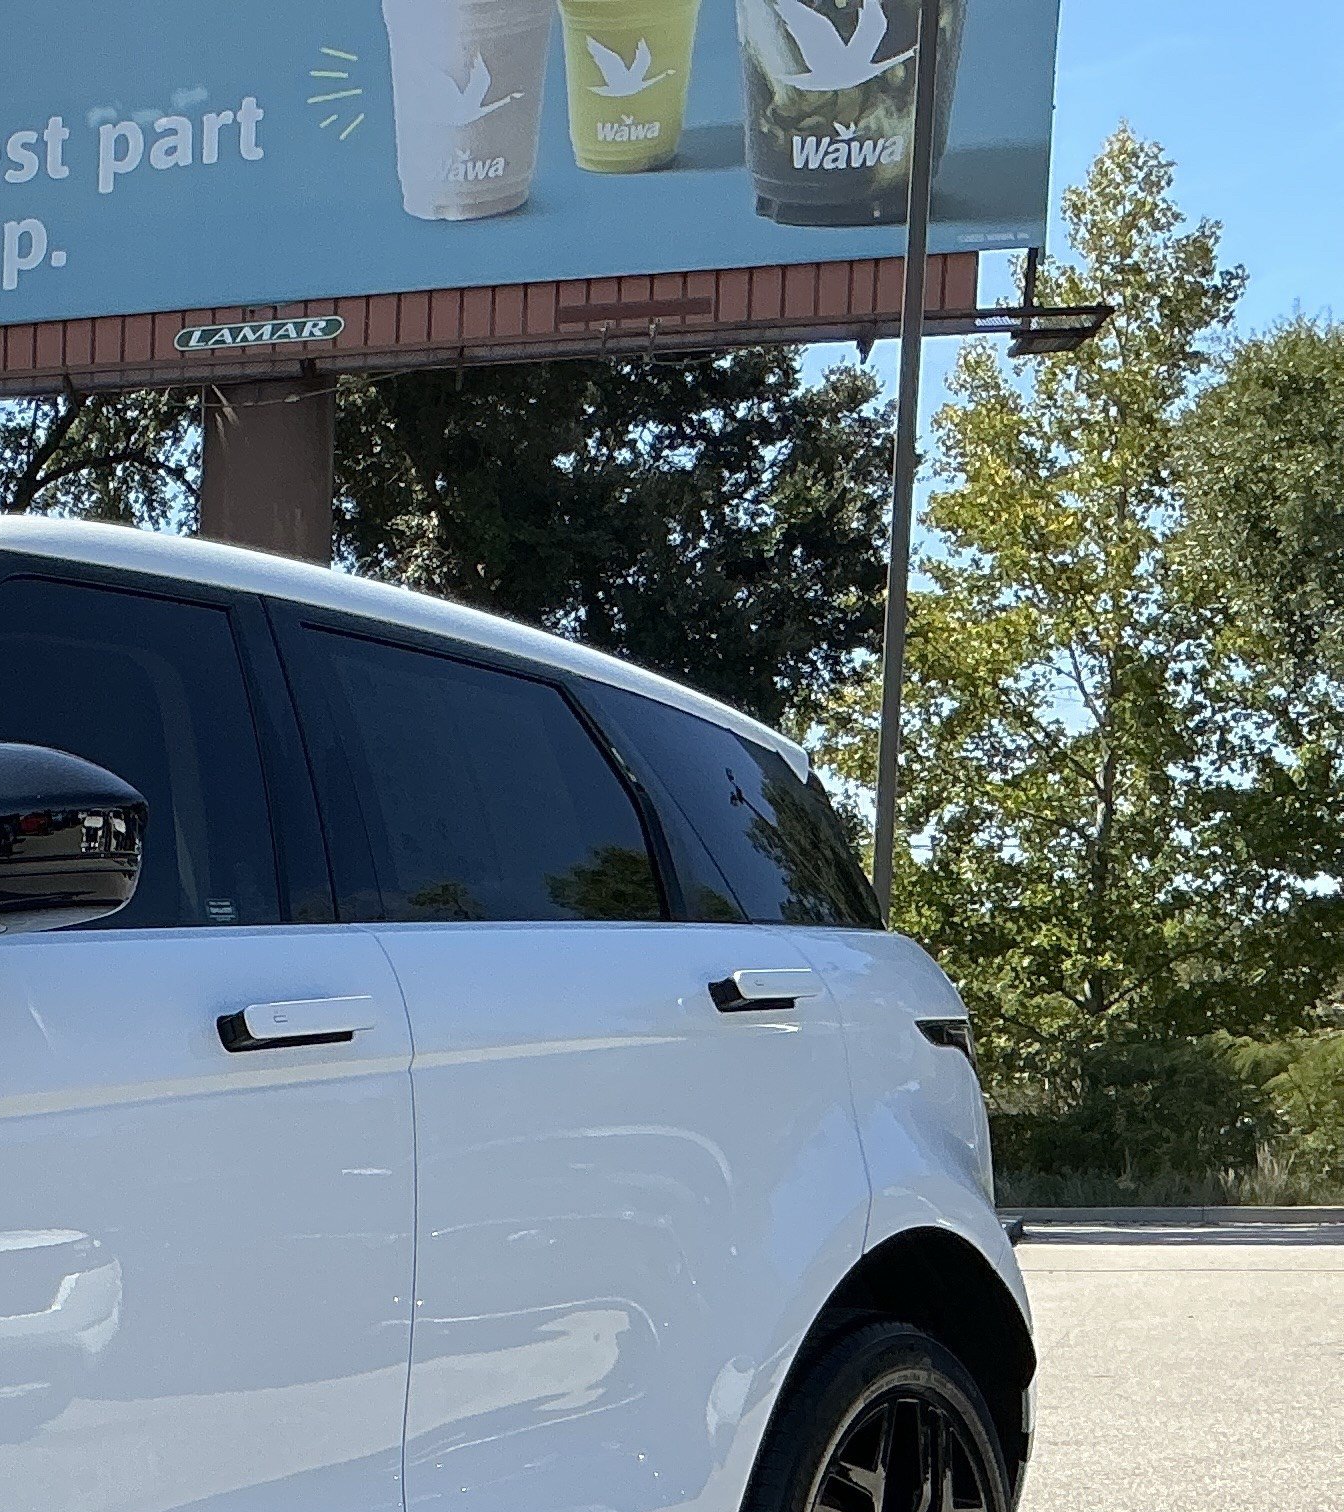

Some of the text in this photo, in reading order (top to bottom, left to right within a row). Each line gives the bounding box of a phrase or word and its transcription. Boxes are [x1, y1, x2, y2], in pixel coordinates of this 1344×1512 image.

[98, 96, 265, 195] part
[596, 120, 661, 142] Wawa
[791, 134, 905, 170] Wawa
[187, 320, 327, 347] LAMAR
